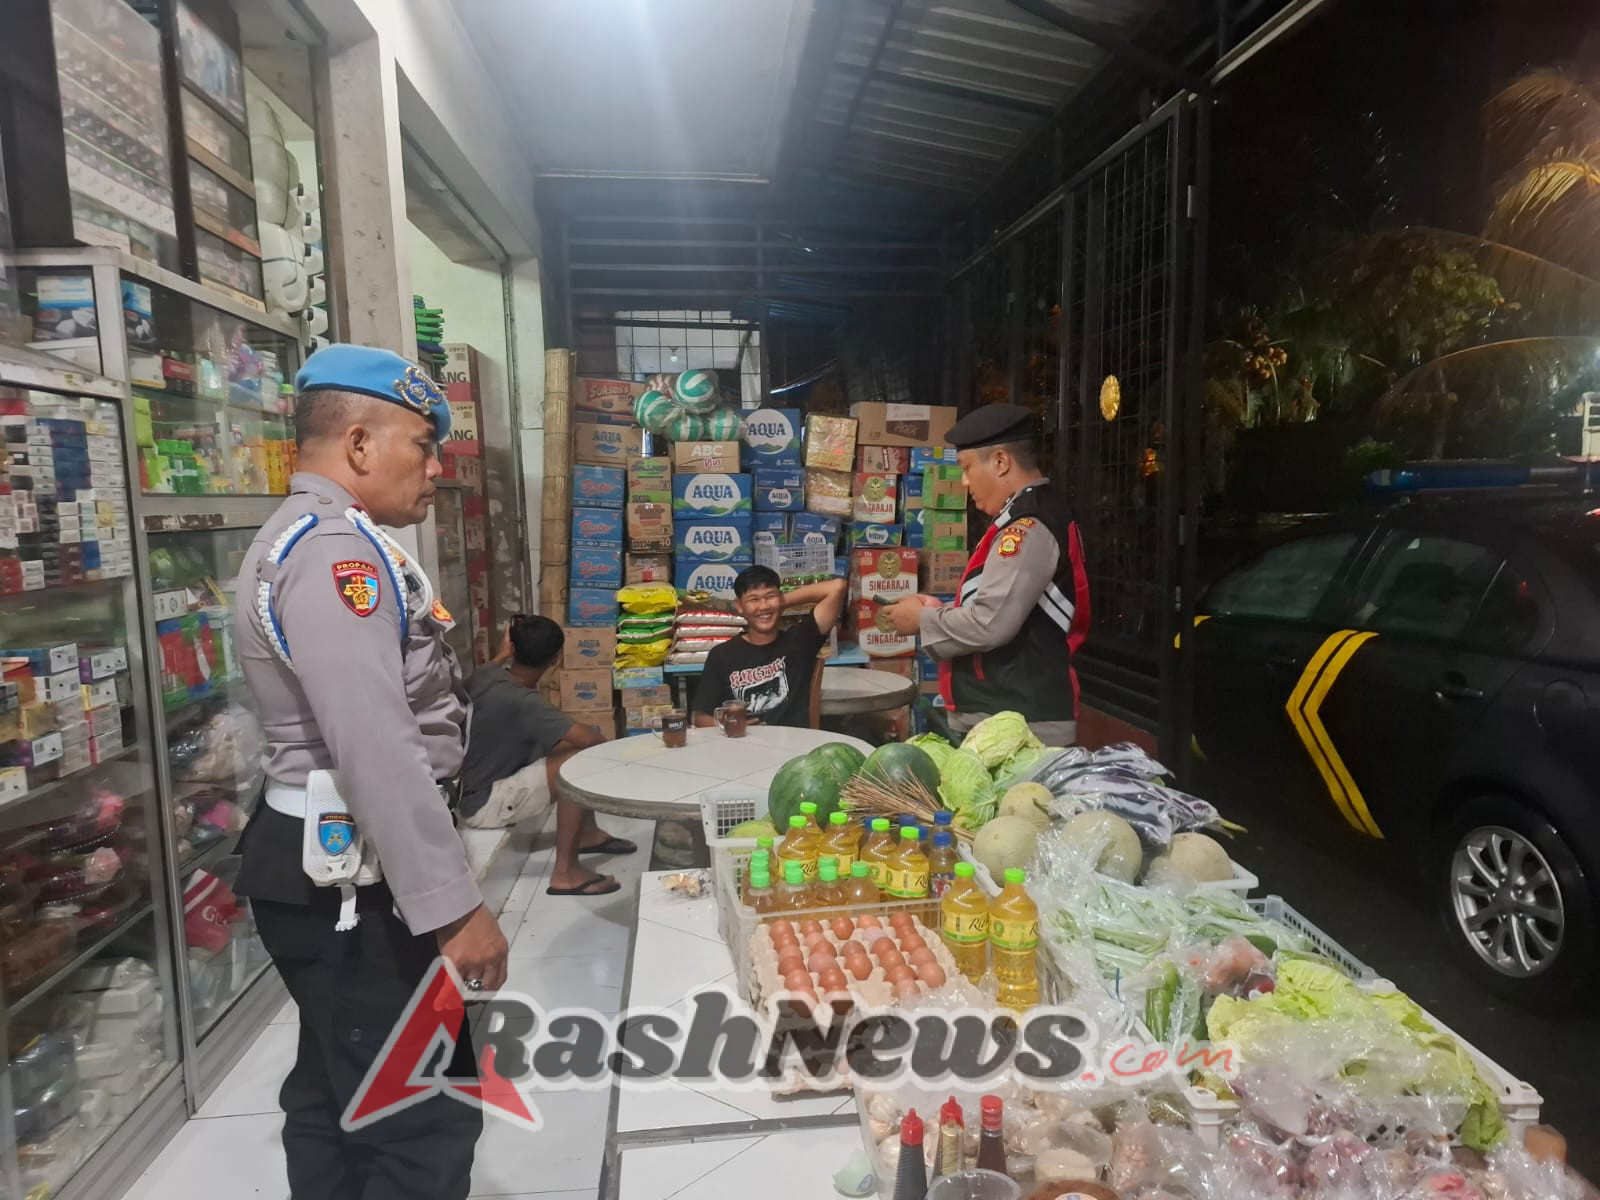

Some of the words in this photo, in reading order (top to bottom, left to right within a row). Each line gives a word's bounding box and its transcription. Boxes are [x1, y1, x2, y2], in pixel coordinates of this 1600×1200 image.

[592, 431, 621, 442] AQUA
[748, 422, 786, 439] AQUA
[691, 444, 723, 457] ABC
[692, 484, 734, 501] AQUA
[692, 530, 734, 546] AQUA
[336, 562, 374, 572] PROPAM
[695, 575, 734, 592] AQUA
[869, 579, 910, 591] SINGARAJA
[578, 640, 600, 648] AQUA
[867, 634, 908, 645] SINGARAJA
[574, 682, 597, 690] AQUA
